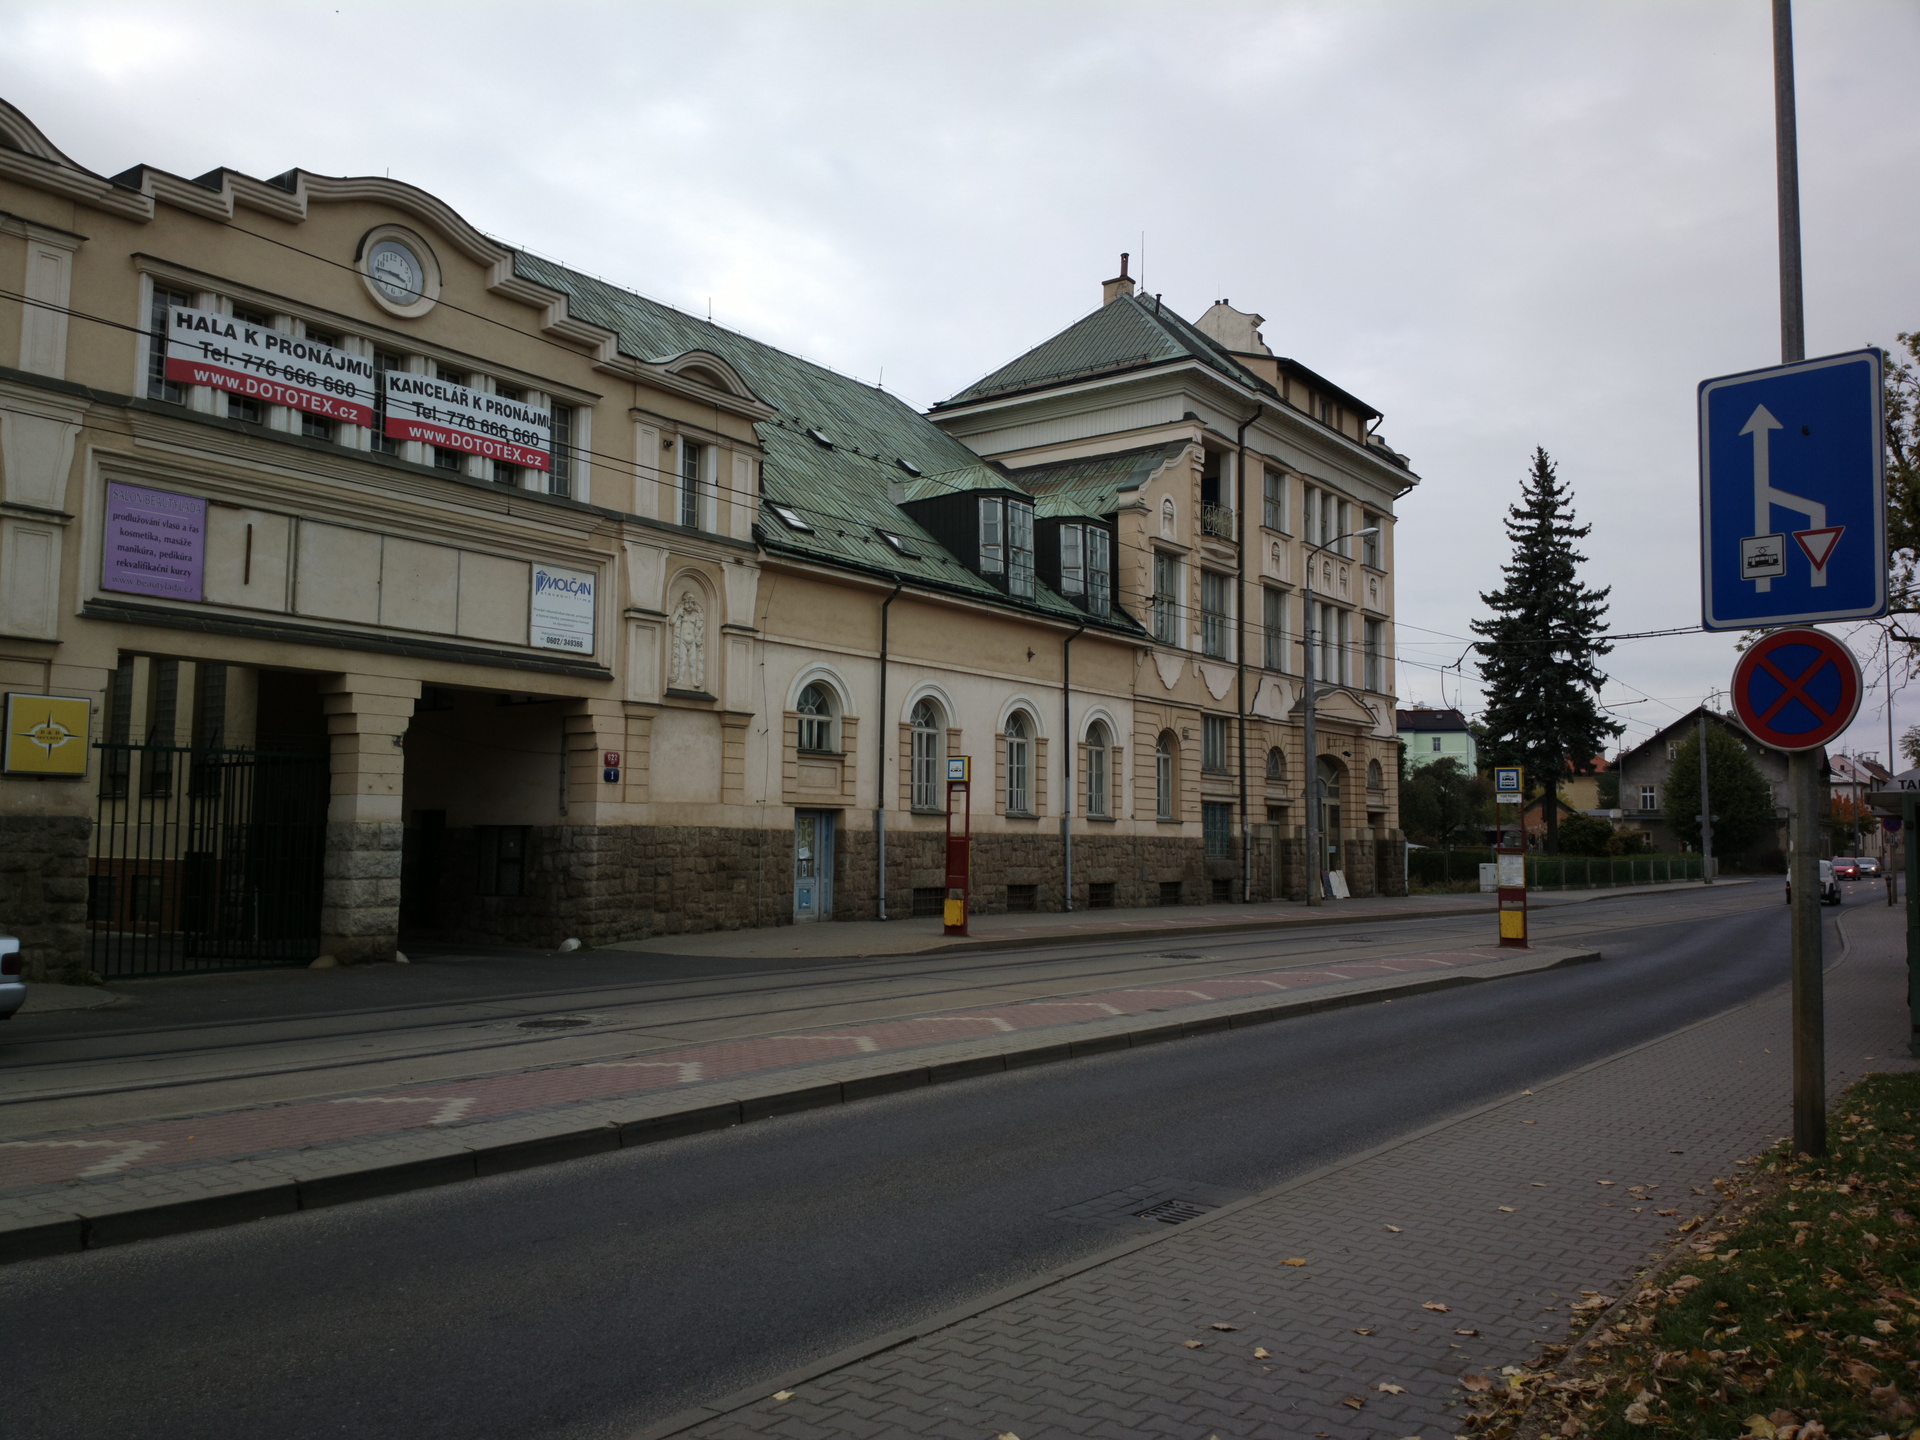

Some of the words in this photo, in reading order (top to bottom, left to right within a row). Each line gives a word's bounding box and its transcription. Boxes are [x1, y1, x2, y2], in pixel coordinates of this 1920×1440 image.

[390, 254, 397, 262] 12
[176, 312, 237, 340] HALA
[245, 328, 259, 346] K
[265, 335, 373, 379] PRONÁJMU
[199, 341, 234, 365] Tel.
[242, 353, 277, 376] 776
[283, 364, 317, 387] 666
[323, 376, 356, 398] 660
[194, 369, 358, 420] www.DOTOTEX.cz
[390, 376, 468, 407] KANCELÁŘ
[473, 396, 482, 410] K
[412, 401, 441, 422] Tel.
[447, 410, 475, 430] 776
[481, 419, 508, 439] 666
[513, 428, 539, 447] 660
[409, 426, 541, 466] www.DOTOTEX.cz
[113, 488, 142, 503] SALON
[112, 512, 160, 526] prodlužování
[188, 525, 199, 534] řas
[119, 527, 161, 543] kosmetika,
[164, 536, 192, 547] masáže
[117, 544, 157, 557] manikúra,
[159, 550, 193, 562] pedikúra
[116, 559, 168, 574] rekvalifikační
[170, 566, 192, 578] kurzy
[541, 576, 591, 596] MOLČAN
[1898, 780, 1920, 790] TA
